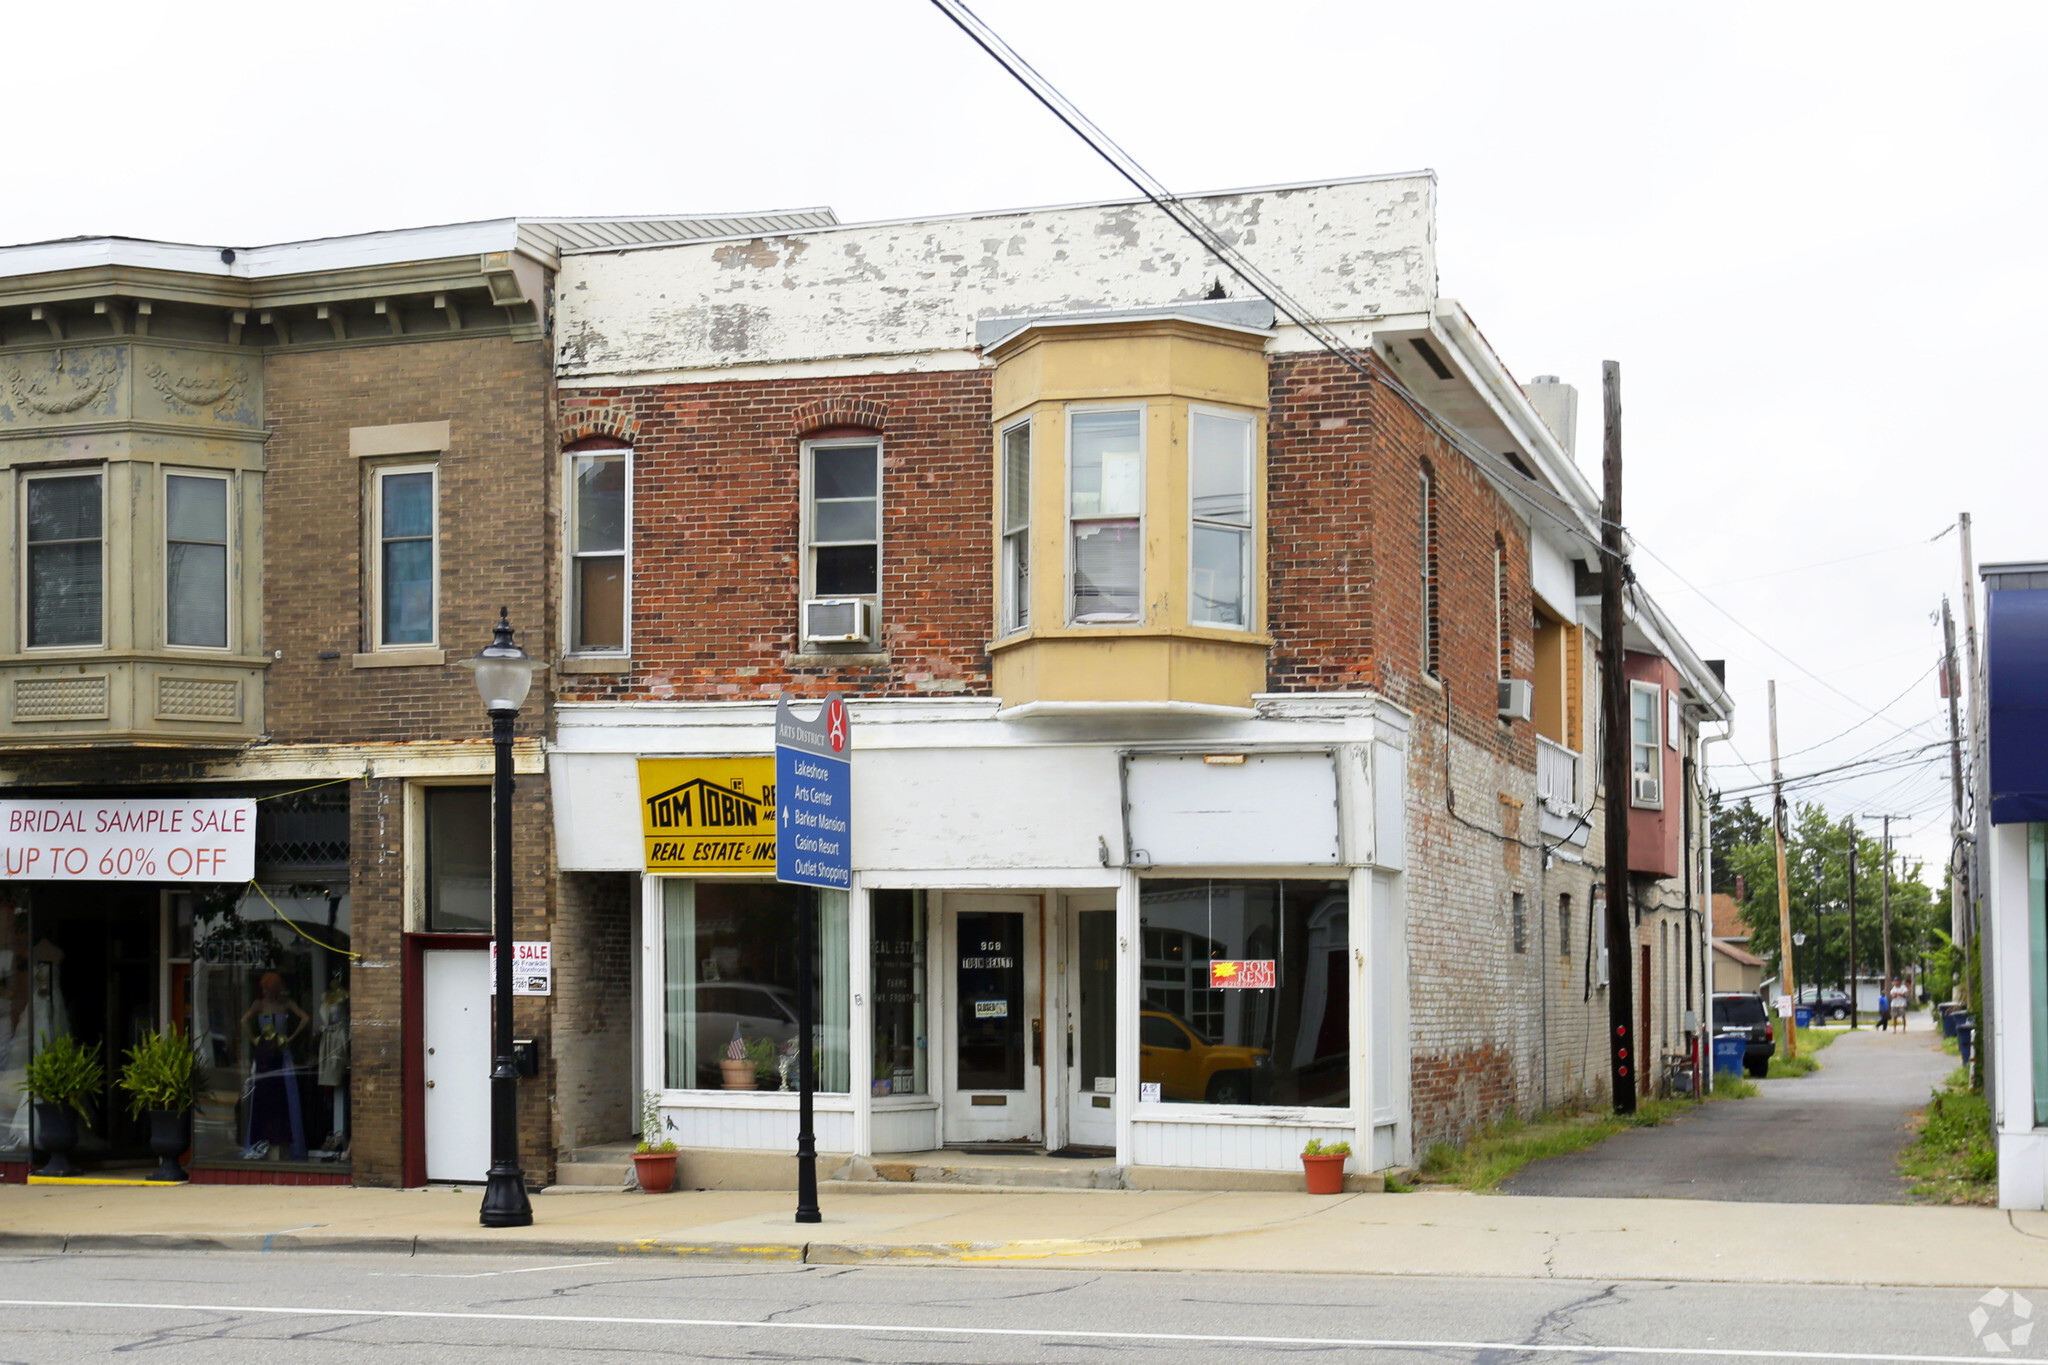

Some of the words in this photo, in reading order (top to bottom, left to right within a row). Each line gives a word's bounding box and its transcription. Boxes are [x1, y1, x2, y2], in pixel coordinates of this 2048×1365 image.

[778, 722, 795, 739] ARTS
[796, 727, 825, 747] DISTRICT
[794, 759, 829, 782] Lakeshore
[647, 784, 693, 827] TOM
[695, 778, 762, 827] TOBIN
[794, 785, 809, 802] Arts
[810, 788, 833, 806] Center
[9, 810, 87, 833] BRIDAL
[95, 810, 184, 832] SAMPLE
[191, 810, 246, 832] SALE
[795, 809, 817, 827] Barker
[819, 813, 846, 833] Mansion
[651, 842, 685, 861] REAL
[692, 842, 745, 861] ESTATE
[795, 834, 817, 852] Casino
[818, 839, 840, 856] Resort
[6, 847, 41, 875] UP
[50, 847, 89, 875] TO
[98, 847, 157, 876] 60%
[167, 847, 227, 876] OFF
[795, 858, 817, 877] Outlet
[818, 862, 849, 885] Shopping
[206, 943, 258, 963] OPEN
[519, 945, 548, 959] SALE
[1237, 970, 1274, 983] RENT
[1242, 960, 1270, 973] FOR
[893, 1075, 902, 1092] FOR
[902, 1075, 914, 1092] RENT
